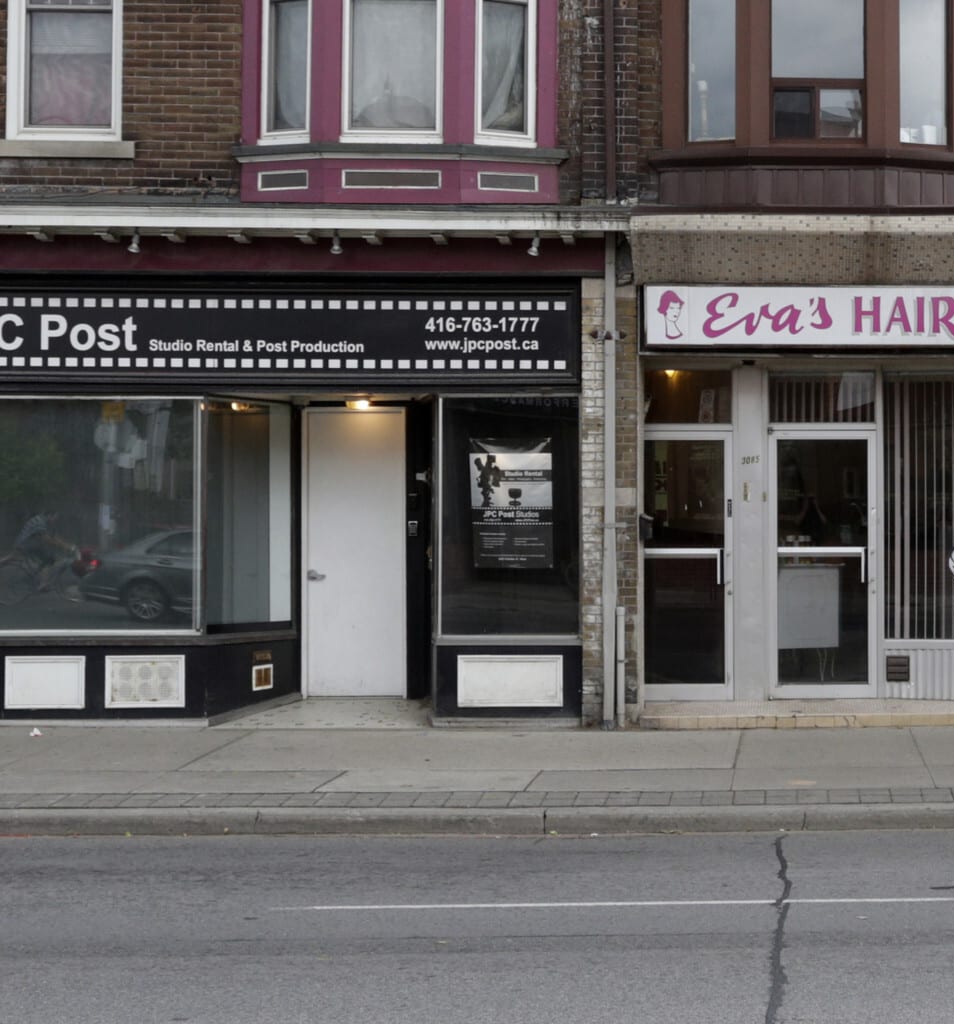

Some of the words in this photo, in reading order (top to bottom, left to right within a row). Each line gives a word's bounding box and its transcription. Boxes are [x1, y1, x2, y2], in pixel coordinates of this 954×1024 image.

[702, 292, 833, 338] Eva's
[40, 314, 138, 352] Post
[424, 317, 540, 333] 416-763-1777
[148, 338, 193, 353] Studio
[196, 339, 240, 353] Rental
[242, 339, 254, 353] &
[256, 340, 288, 353] Post
[290, 340, 365, 354] Production
[424, 337, 540, 354] www.jpcpost.ca
[483, 510, 497, 518] JPC
[498, 510, 515, 518] Post
[515, 510, 540, 518] Studios
